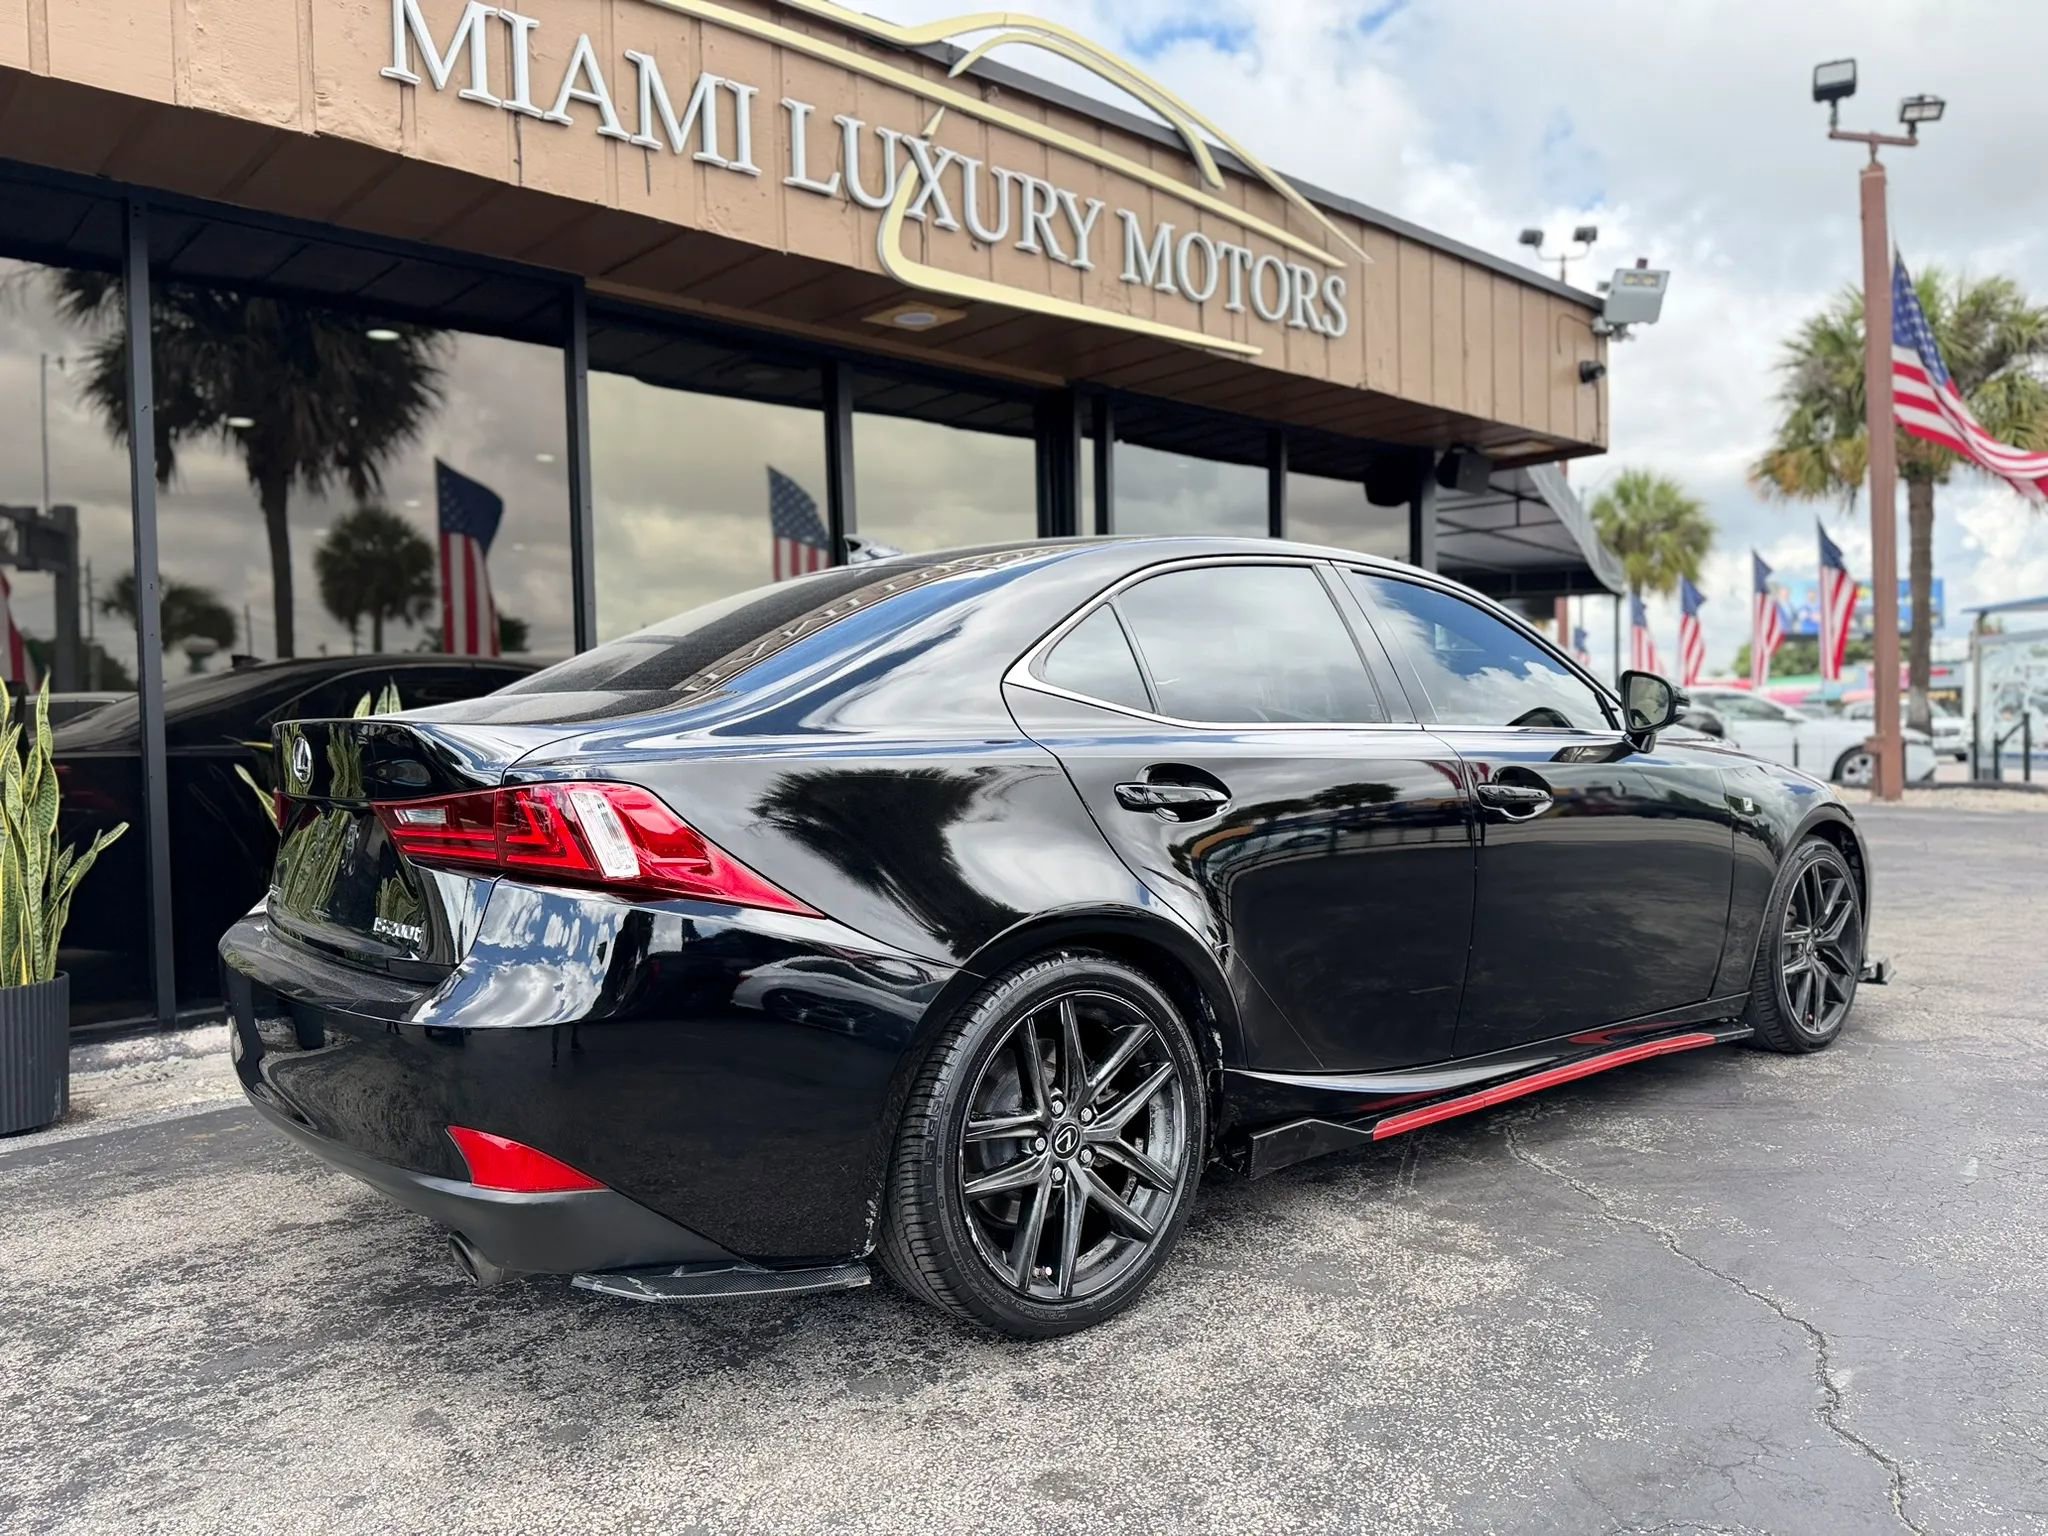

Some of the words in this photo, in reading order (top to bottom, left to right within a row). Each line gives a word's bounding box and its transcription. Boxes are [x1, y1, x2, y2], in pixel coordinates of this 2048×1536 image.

[380, 0, 762, 177] MIAMI
[781, 96, 1106, 272] LUXURY
[1116, 207, 1349, 339] MOTORS
